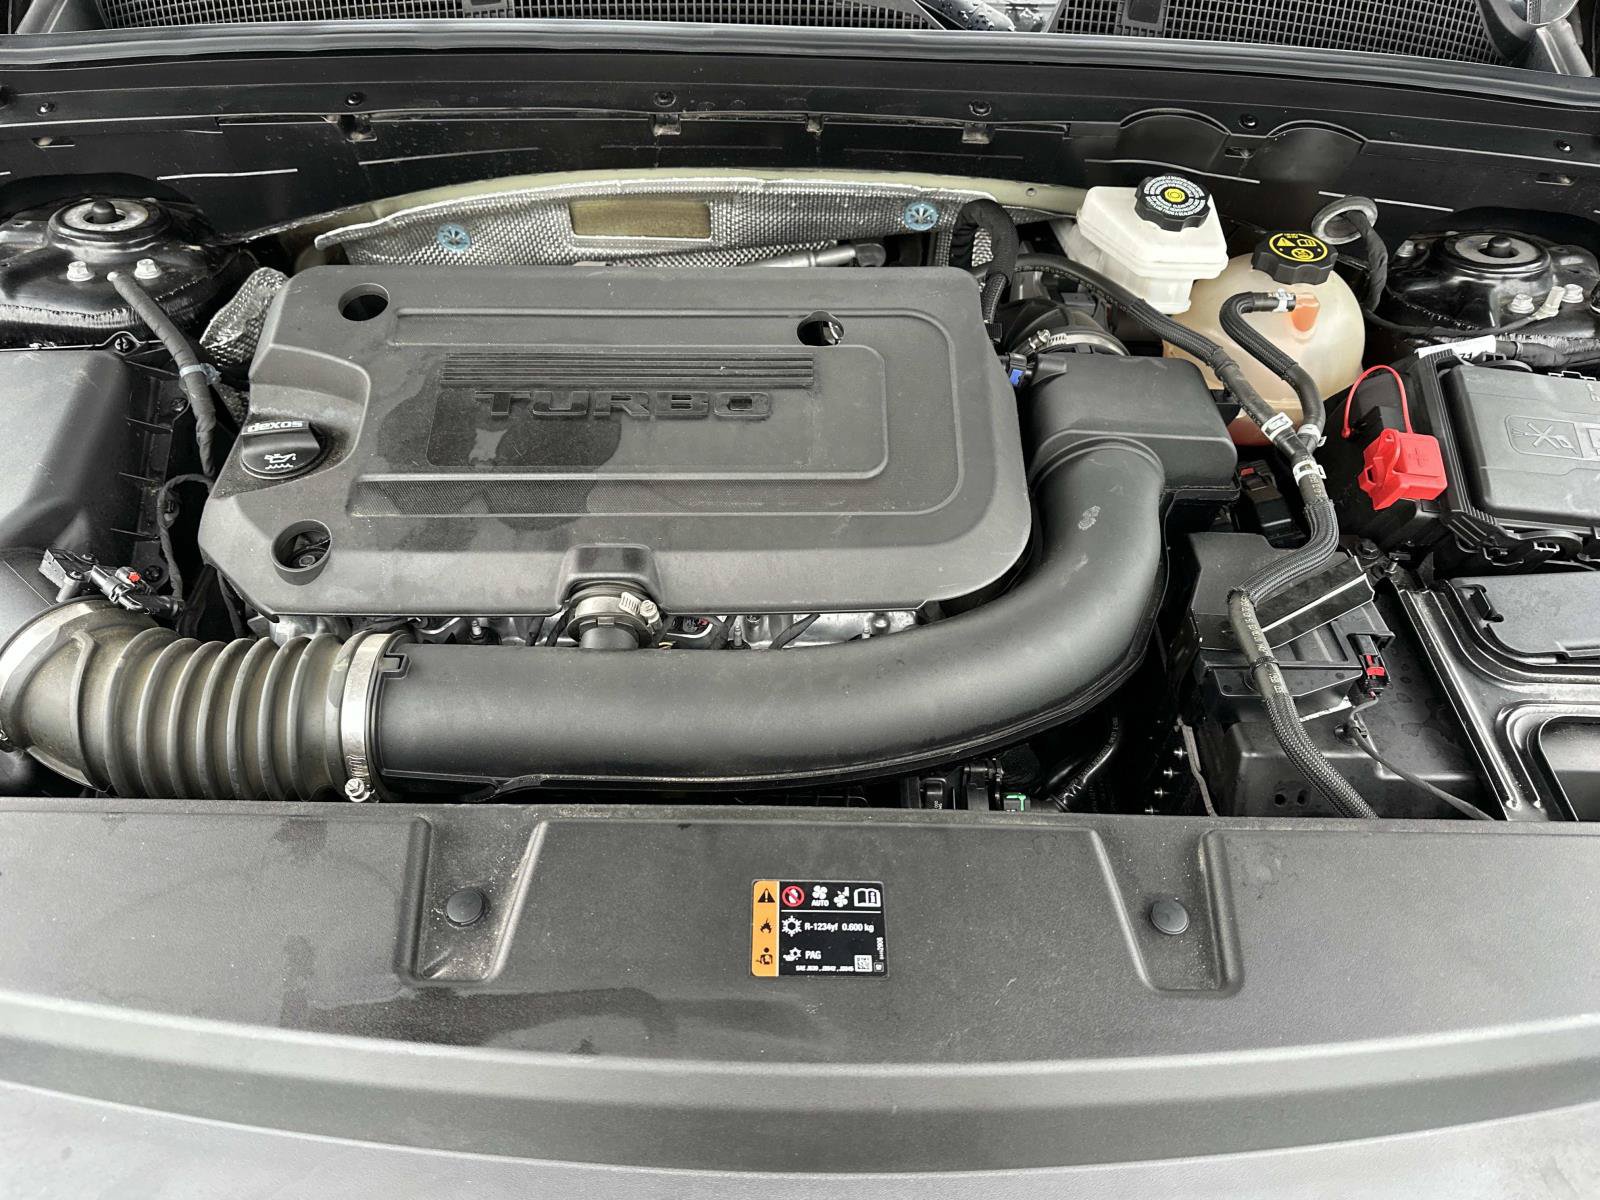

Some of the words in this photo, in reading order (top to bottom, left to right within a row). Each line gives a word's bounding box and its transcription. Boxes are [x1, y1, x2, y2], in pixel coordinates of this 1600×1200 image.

[475, 390, 769, 417] TURBO
[247, 420, 304, 433] dexos
[804, 922, 838, 932] R-1234yf
[842, 923, 863, 932] 0.600
[864, 923, 874, 933] kg
[805, 950, 821, 960] PAG
